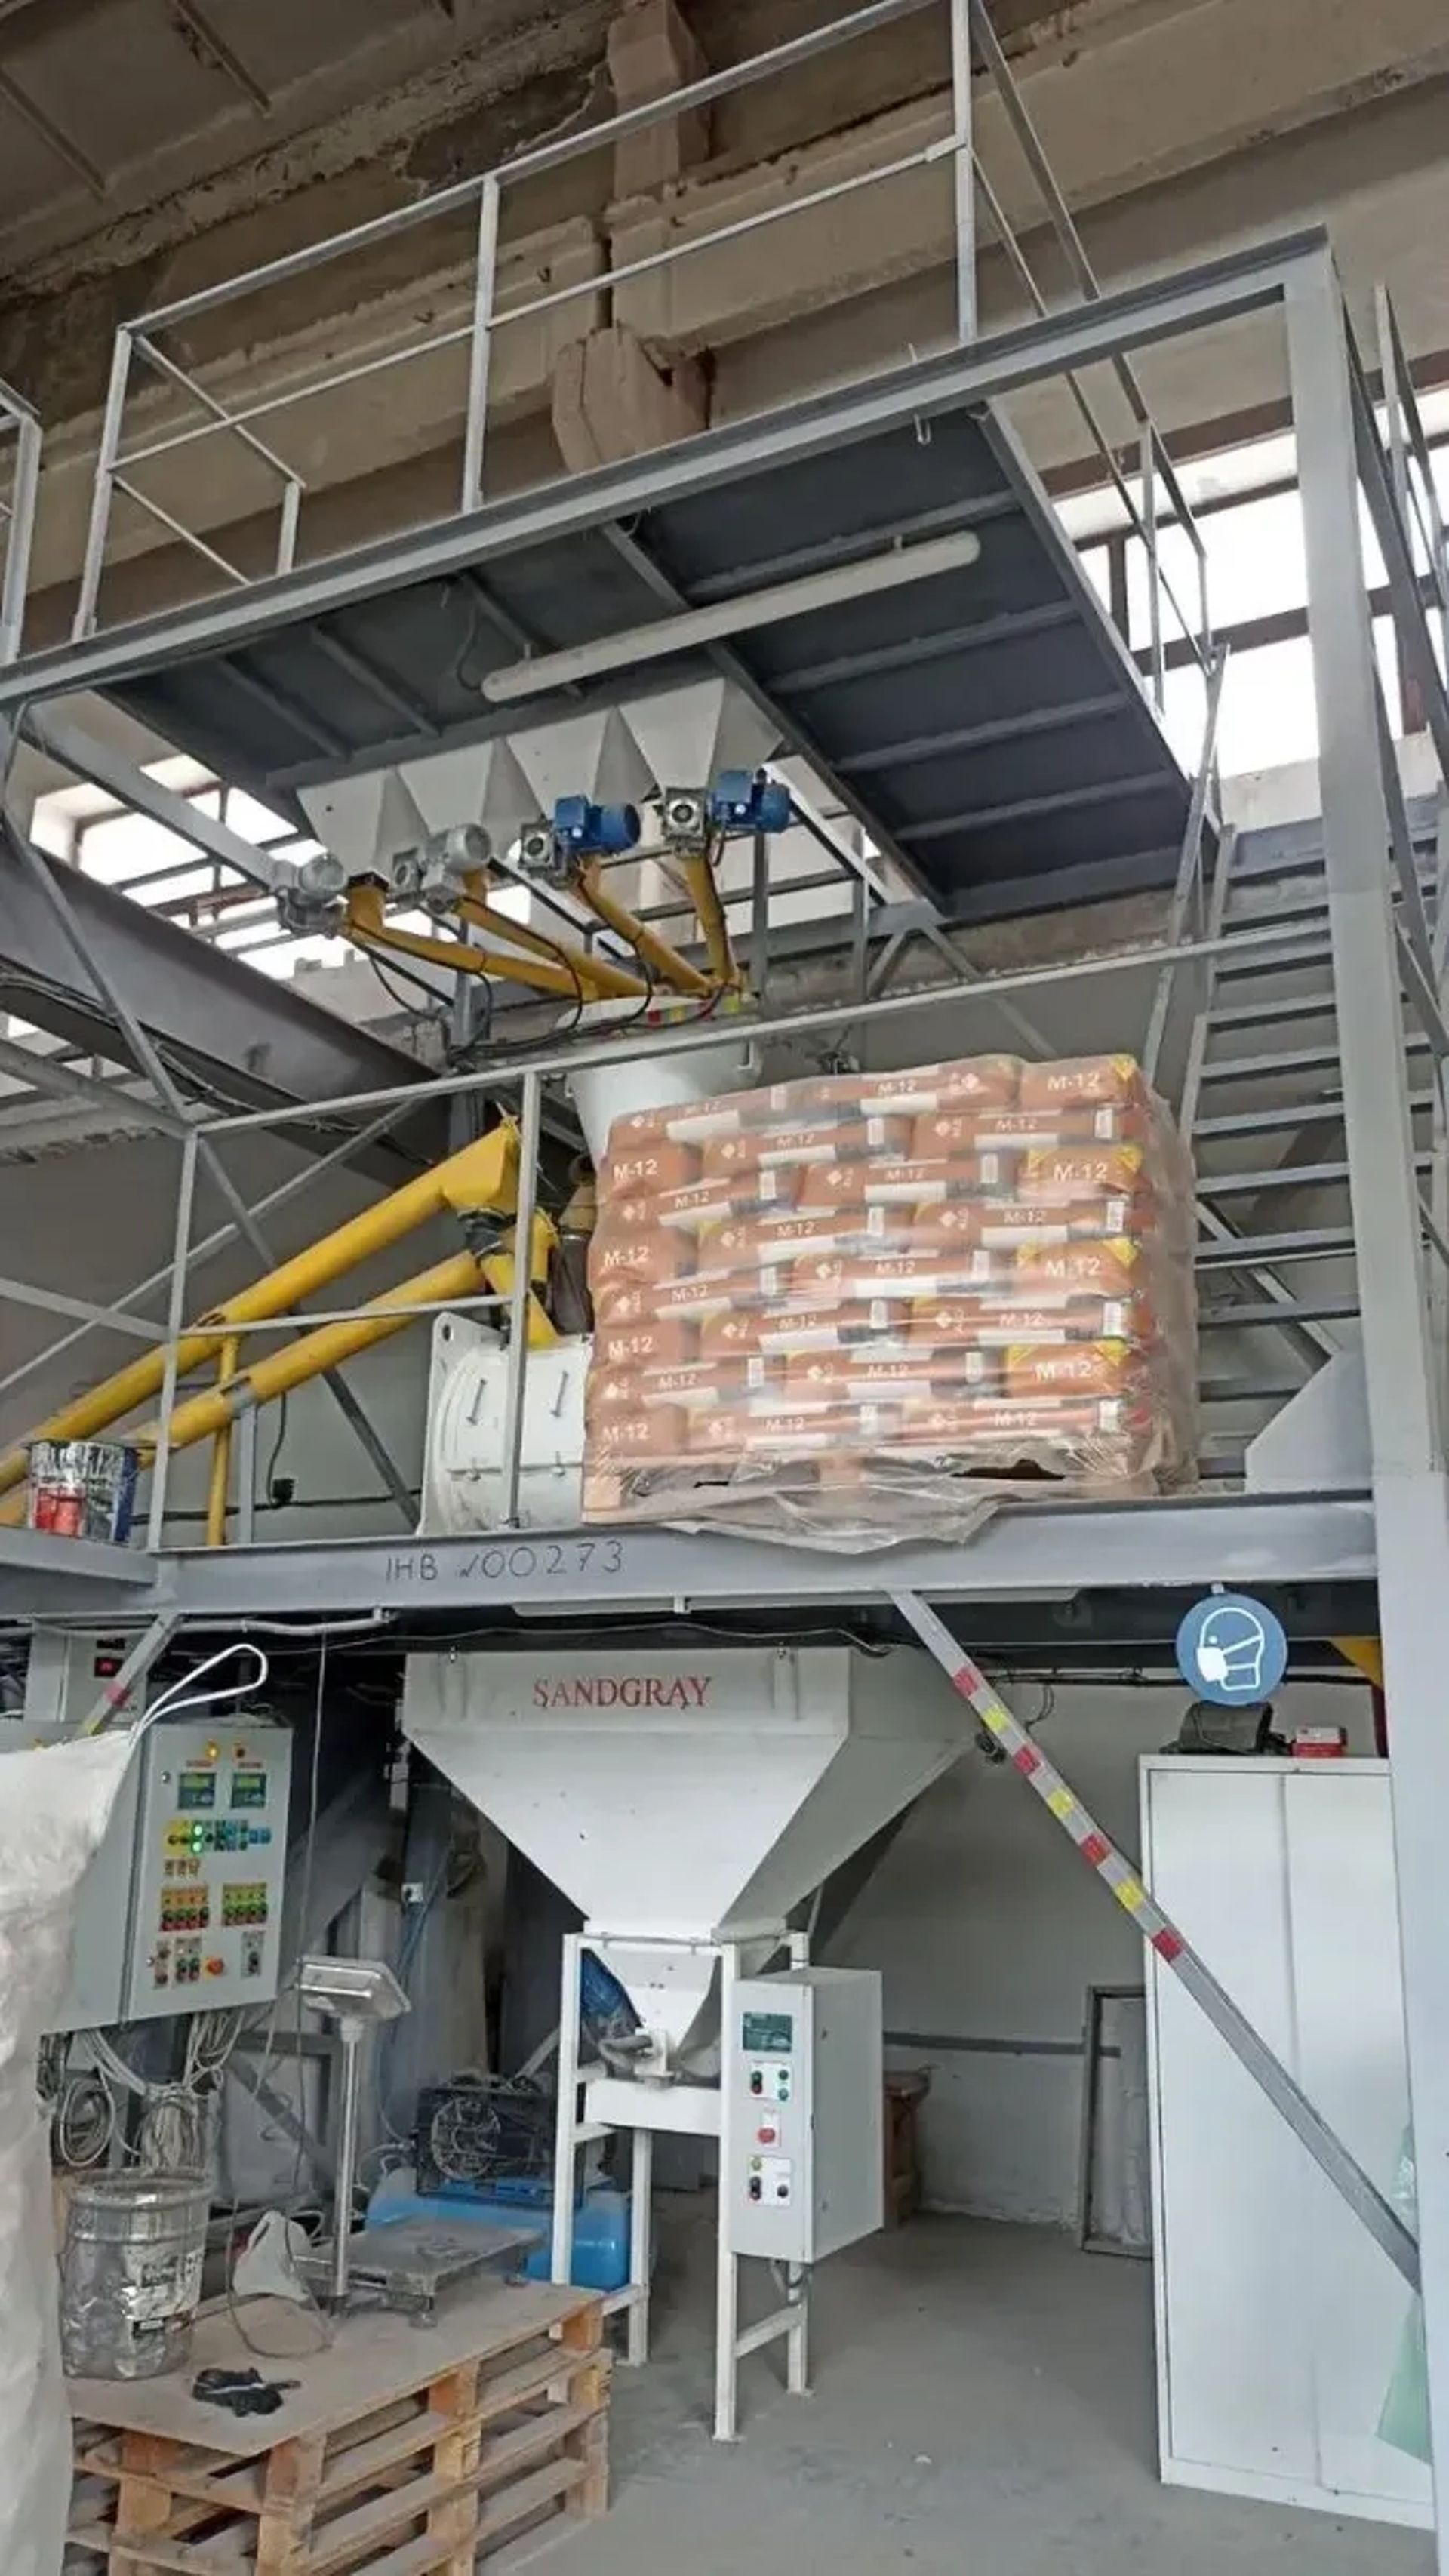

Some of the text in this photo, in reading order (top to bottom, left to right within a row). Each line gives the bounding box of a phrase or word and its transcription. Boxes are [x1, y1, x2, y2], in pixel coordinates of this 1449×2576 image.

[878, 1081, 916, 1093] M-12
[1048, 1073, 1099, 1089] M-12
[777, 1134, 814, 1146] M-12
[614, 1159, 657, 1178] M-12
[1054, 1163, 1107, 1181] M-12
[675, 1193, 709, 1208] M-12
[778, 1223, 815, 1236] M-12
[605, 1247, 649, 1265] M-12
[1047, 1256, 1100, 1276] M-12
[609, 1337, 653, 1356] M-12
[1036, 1362, 1092, 1381] M-12
[605, 1424, 648, 1442] M-12
[533, 1676, 712, 1709] SANDGRAY
